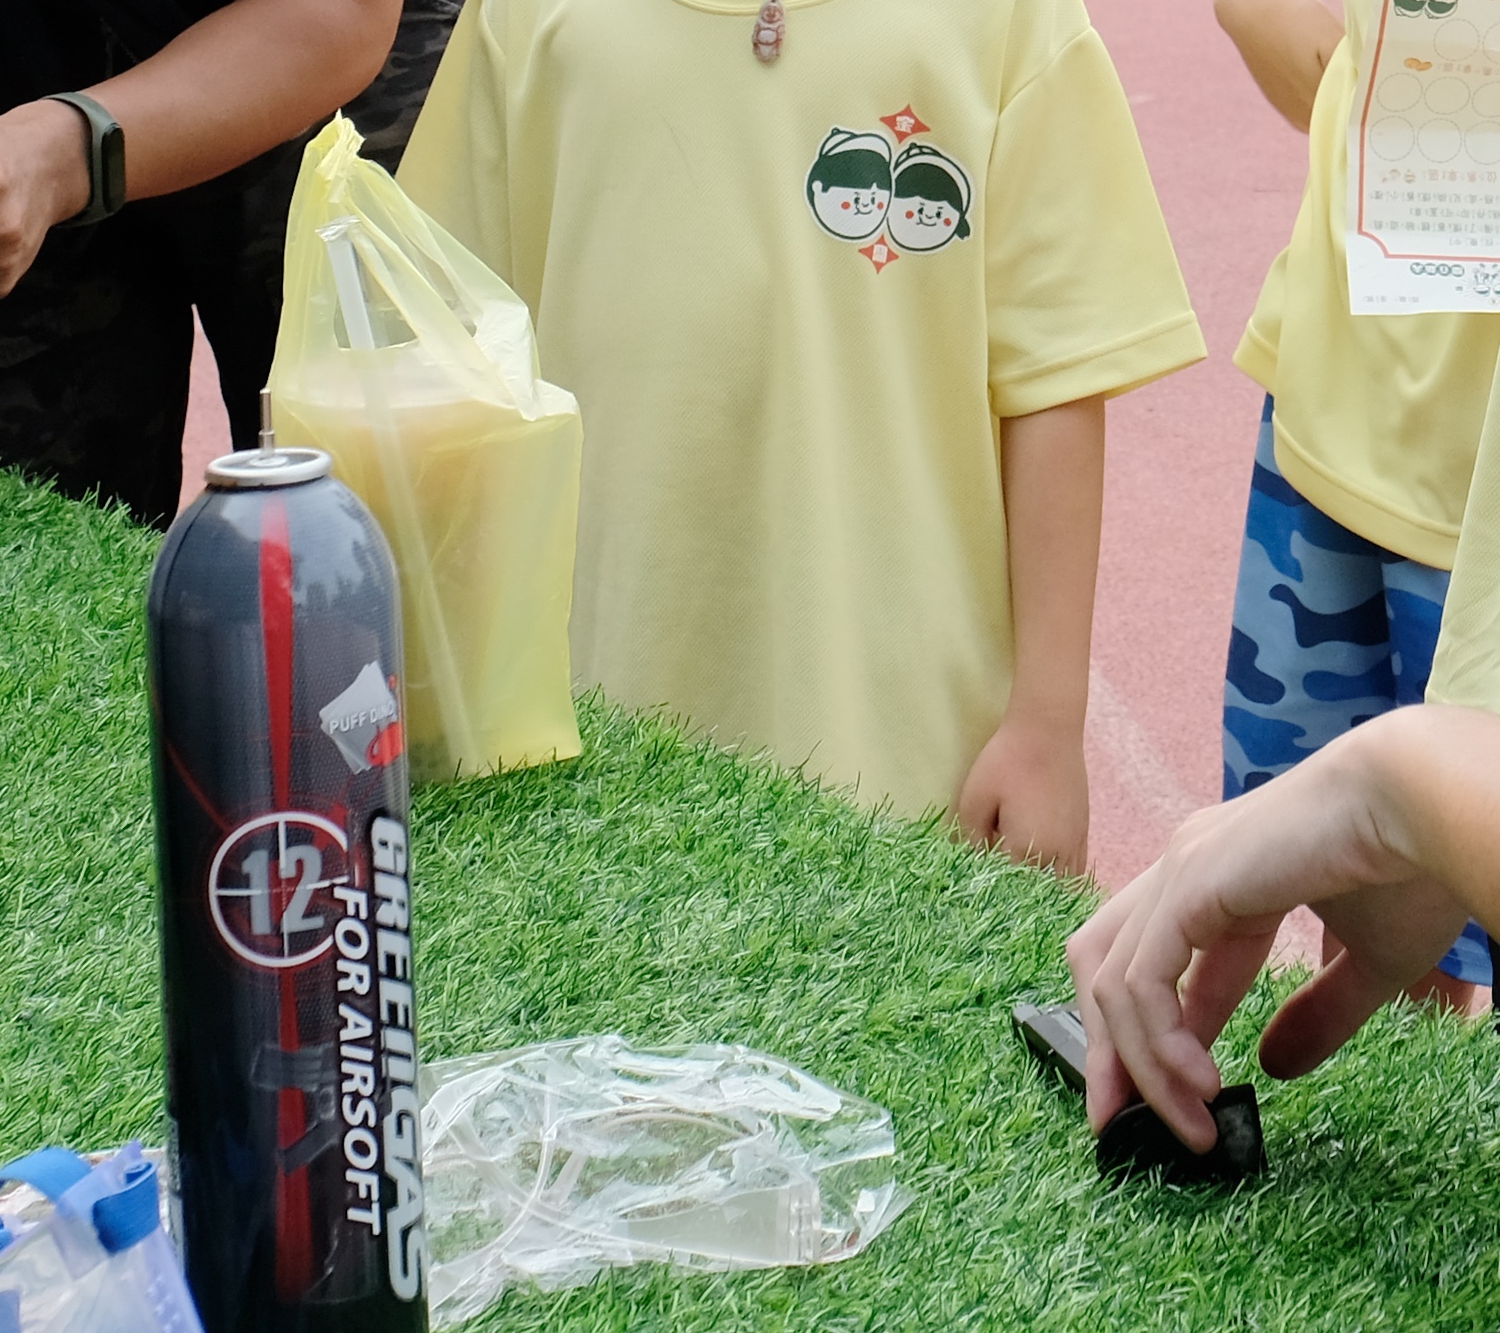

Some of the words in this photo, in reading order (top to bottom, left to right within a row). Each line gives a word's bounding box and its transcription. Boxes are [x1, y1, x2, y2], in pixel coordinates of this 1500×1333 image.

[894, 115, 915, 133] 金
[328, 711, 368, 735] PUFF
[242, 846, 324, 935] 12
[334, 886, 372, 998] FOR
[336, 1005, 382, 1238] AIRSOFT
